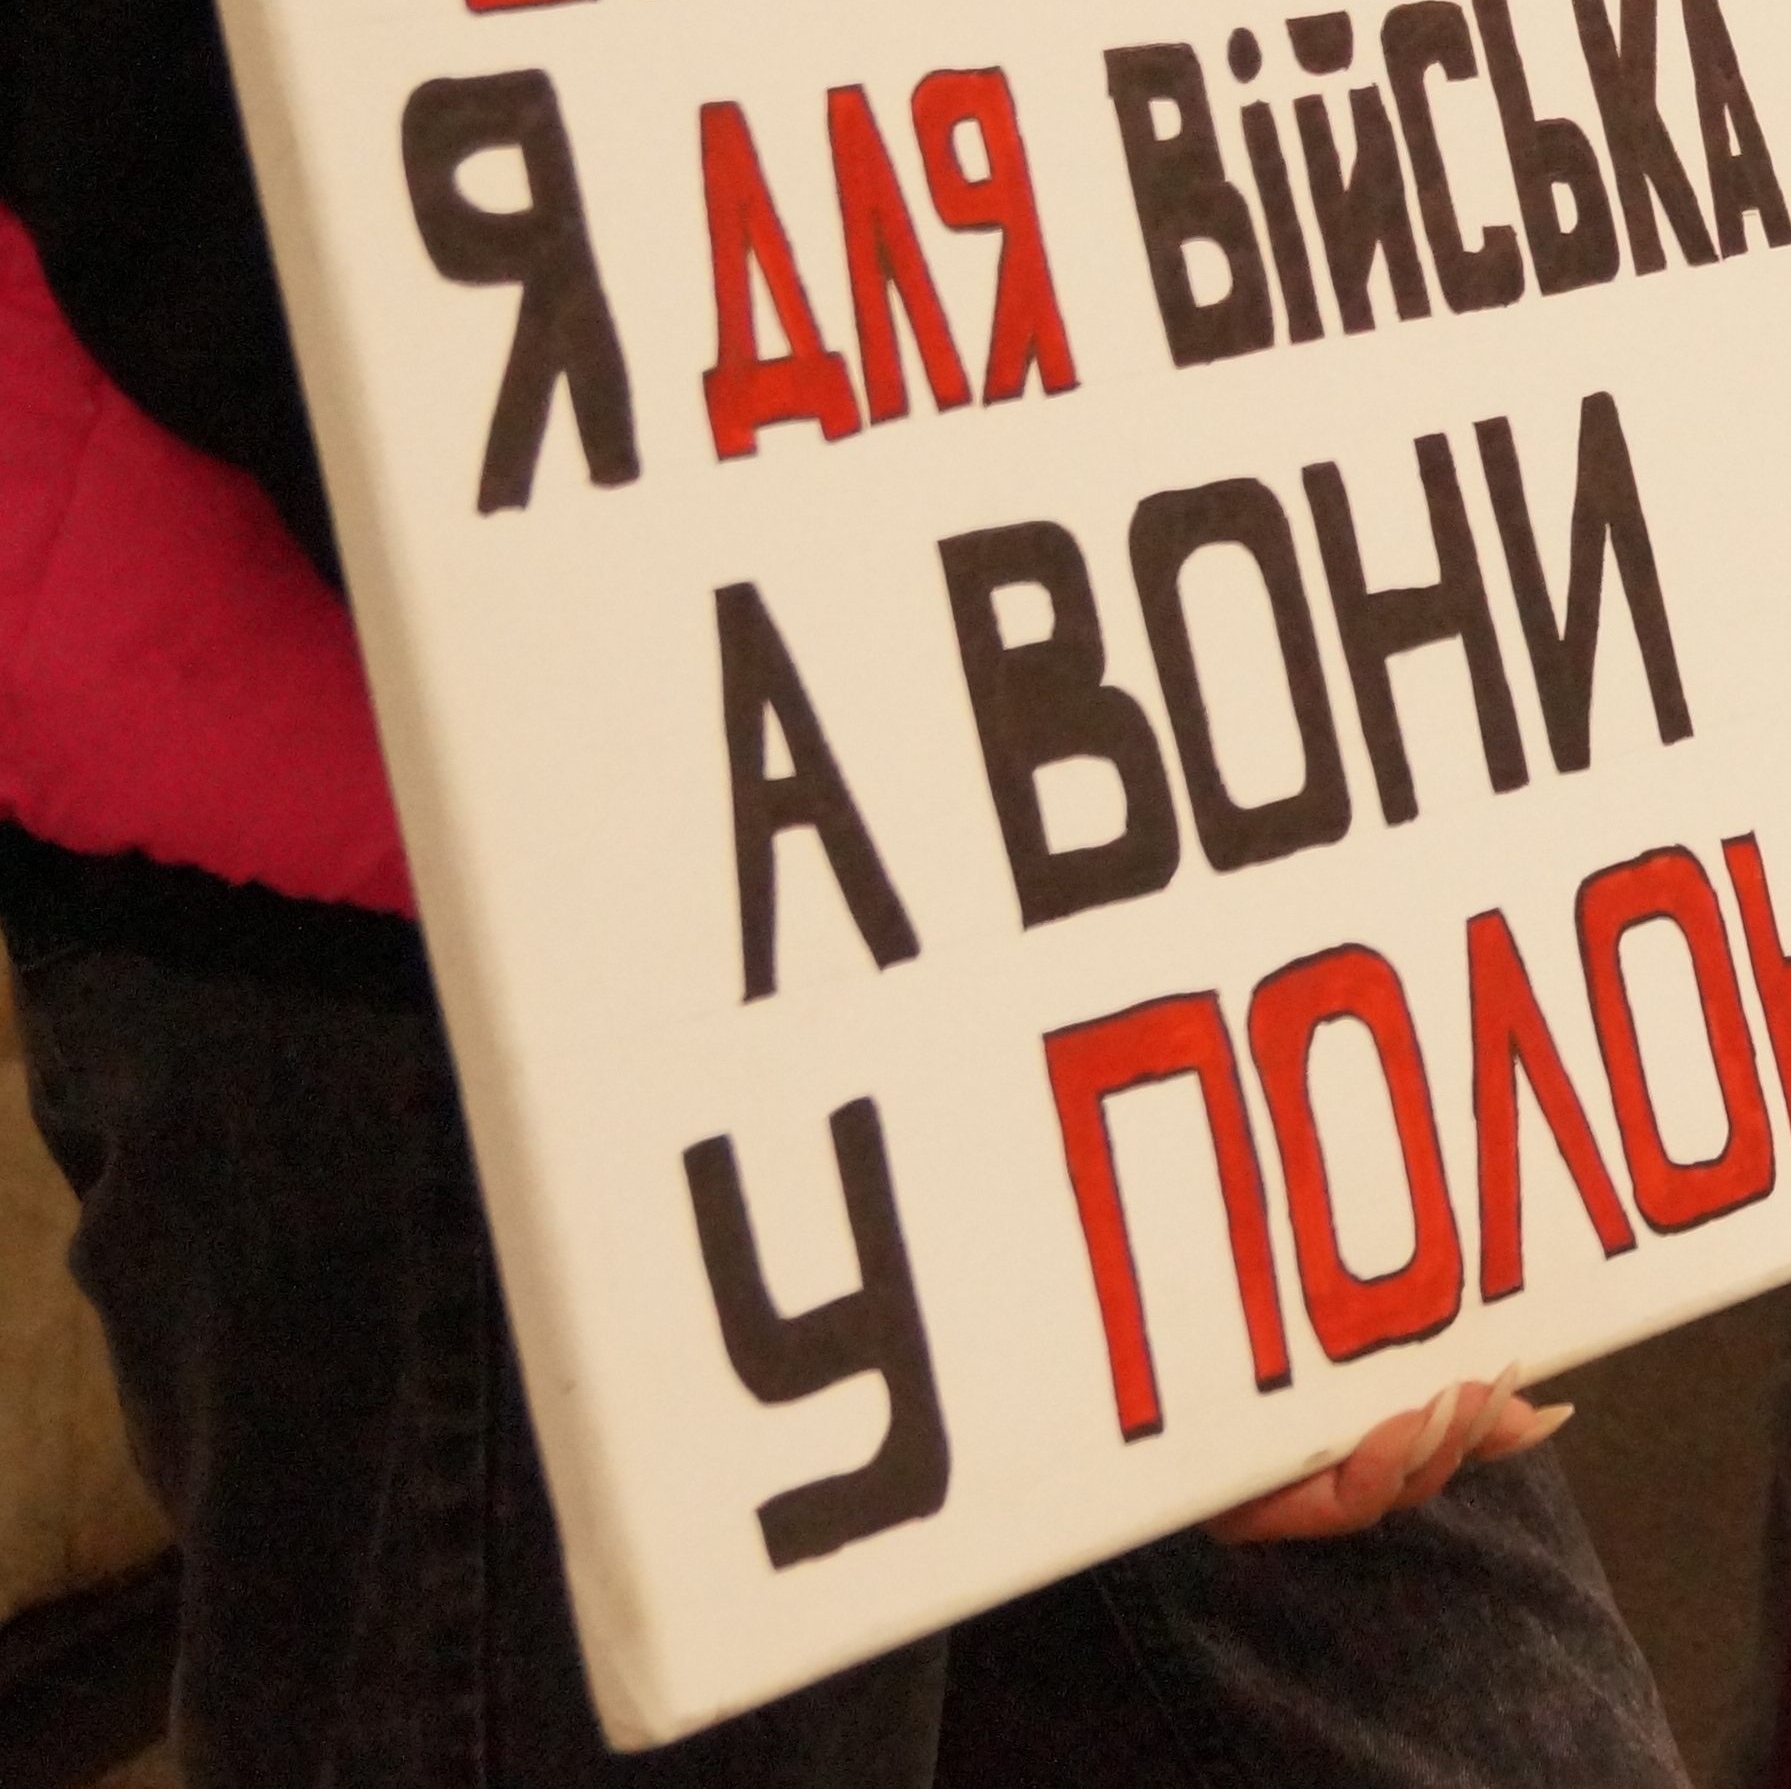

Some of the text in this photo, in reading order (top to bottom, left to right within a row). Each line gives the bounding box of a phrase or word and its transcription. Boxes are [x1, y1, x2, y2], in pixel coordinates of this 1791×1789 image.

[399, 68, 640, 516] Я
[698, 65, 1080, 461] ДЛЯ
[711, 389, 1694, 1004] А ВОНИ
[681, 1095, 953, 1571] У
